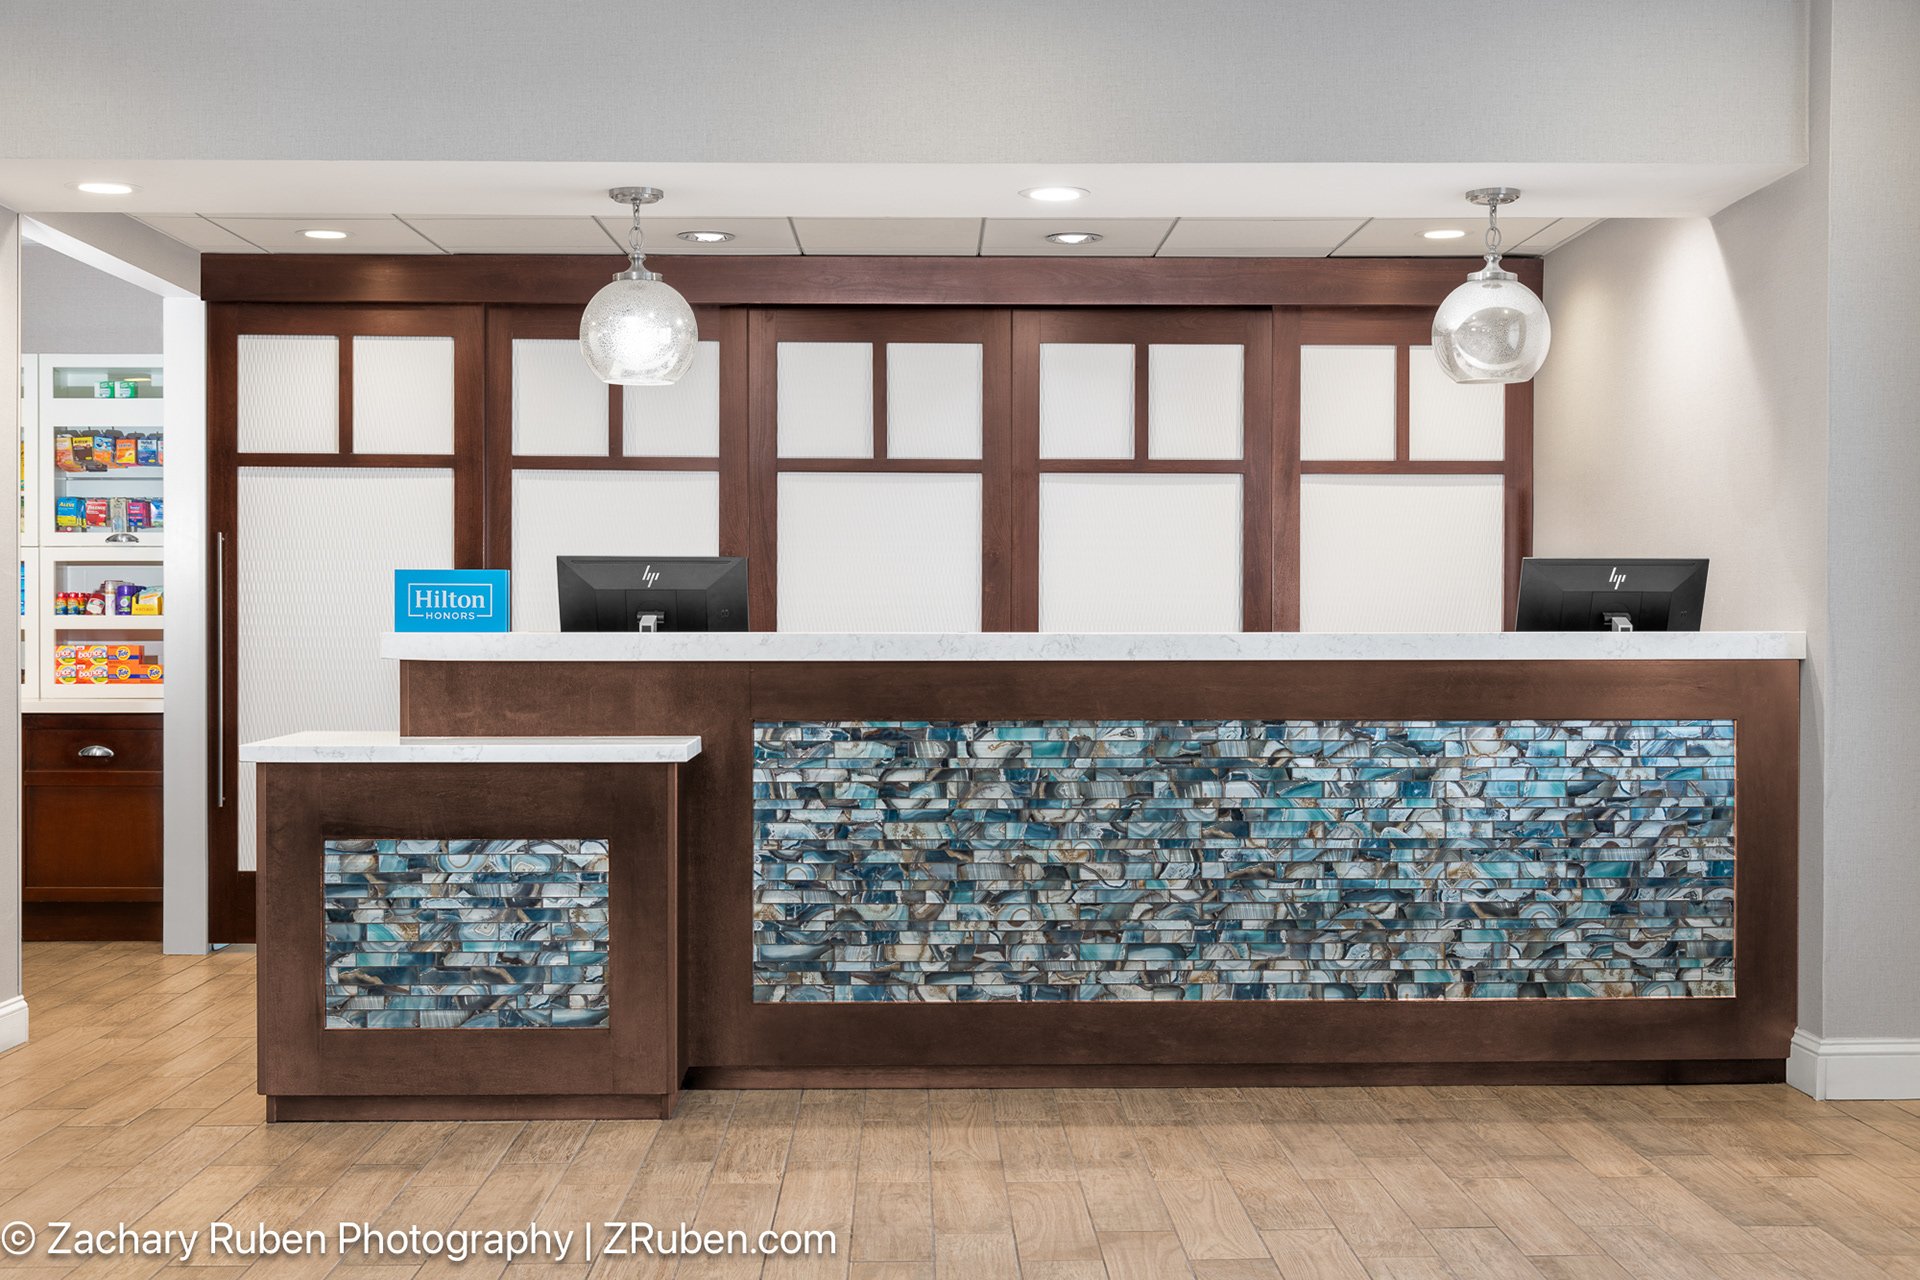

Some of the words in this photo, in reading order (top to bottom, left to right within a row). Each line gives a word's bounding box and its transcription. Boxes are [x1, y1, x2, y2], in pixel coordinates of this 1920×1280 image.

[642, 565, 660, 588] hp
[1608, 566, 1627, 590] hp
[415, 589, 486, 609] Hilton
[425, 611, 475, 620] HONORS
[117, 649, 129, 658] Tide
[117, 668, 130, 677] Tide
[148, 668, 161, 677] Tide
